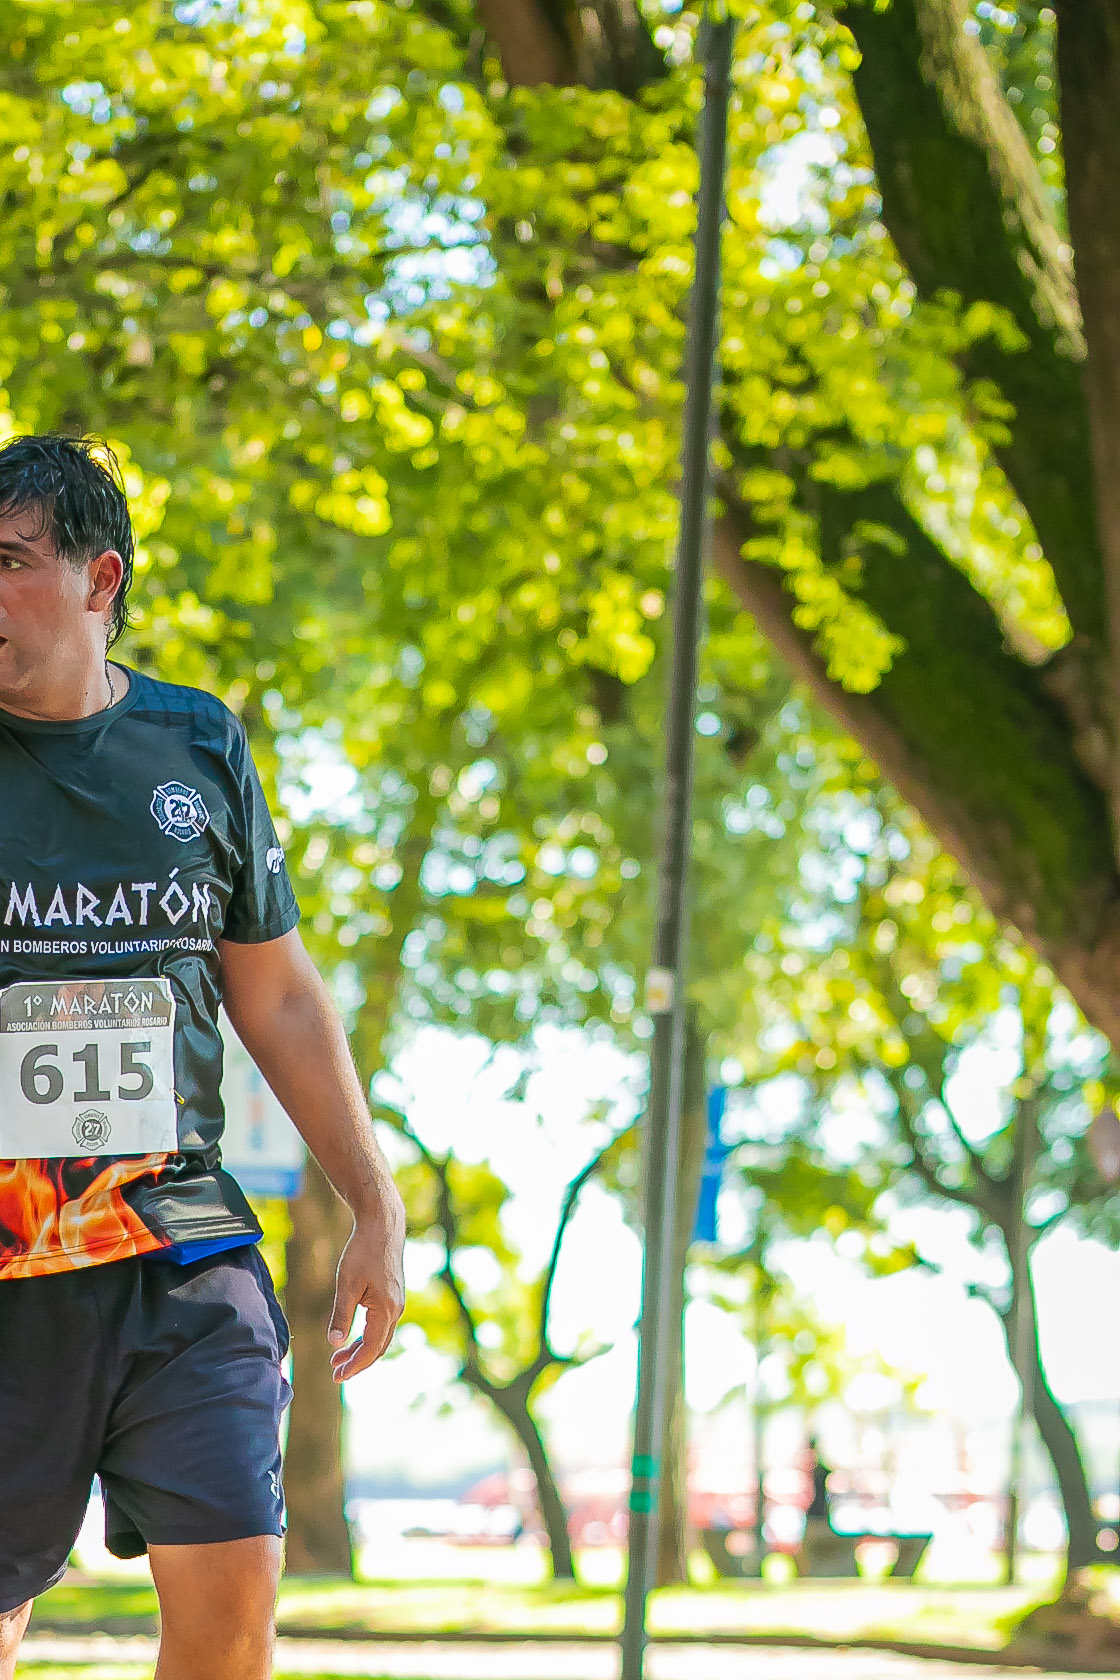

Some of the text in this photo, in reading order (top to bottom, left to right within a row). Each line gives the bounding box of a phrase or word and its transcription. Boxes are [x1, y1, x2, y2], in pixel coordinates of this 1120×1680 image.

[169, 798, 191, 819] 27
[3, 867, 211, 928] MARATÓN
[13, 940, 88, 955] BOMBEROS
[49, 985, 154, 1016] MARATÓN
[6, 1016, 168, 1032] ASOCIACIÓN BOMBEROS VOLUNTARIOS ROSARIO
[20, 1041, 154, 1105] 615
[84, 1121, 101, 1137] 27
